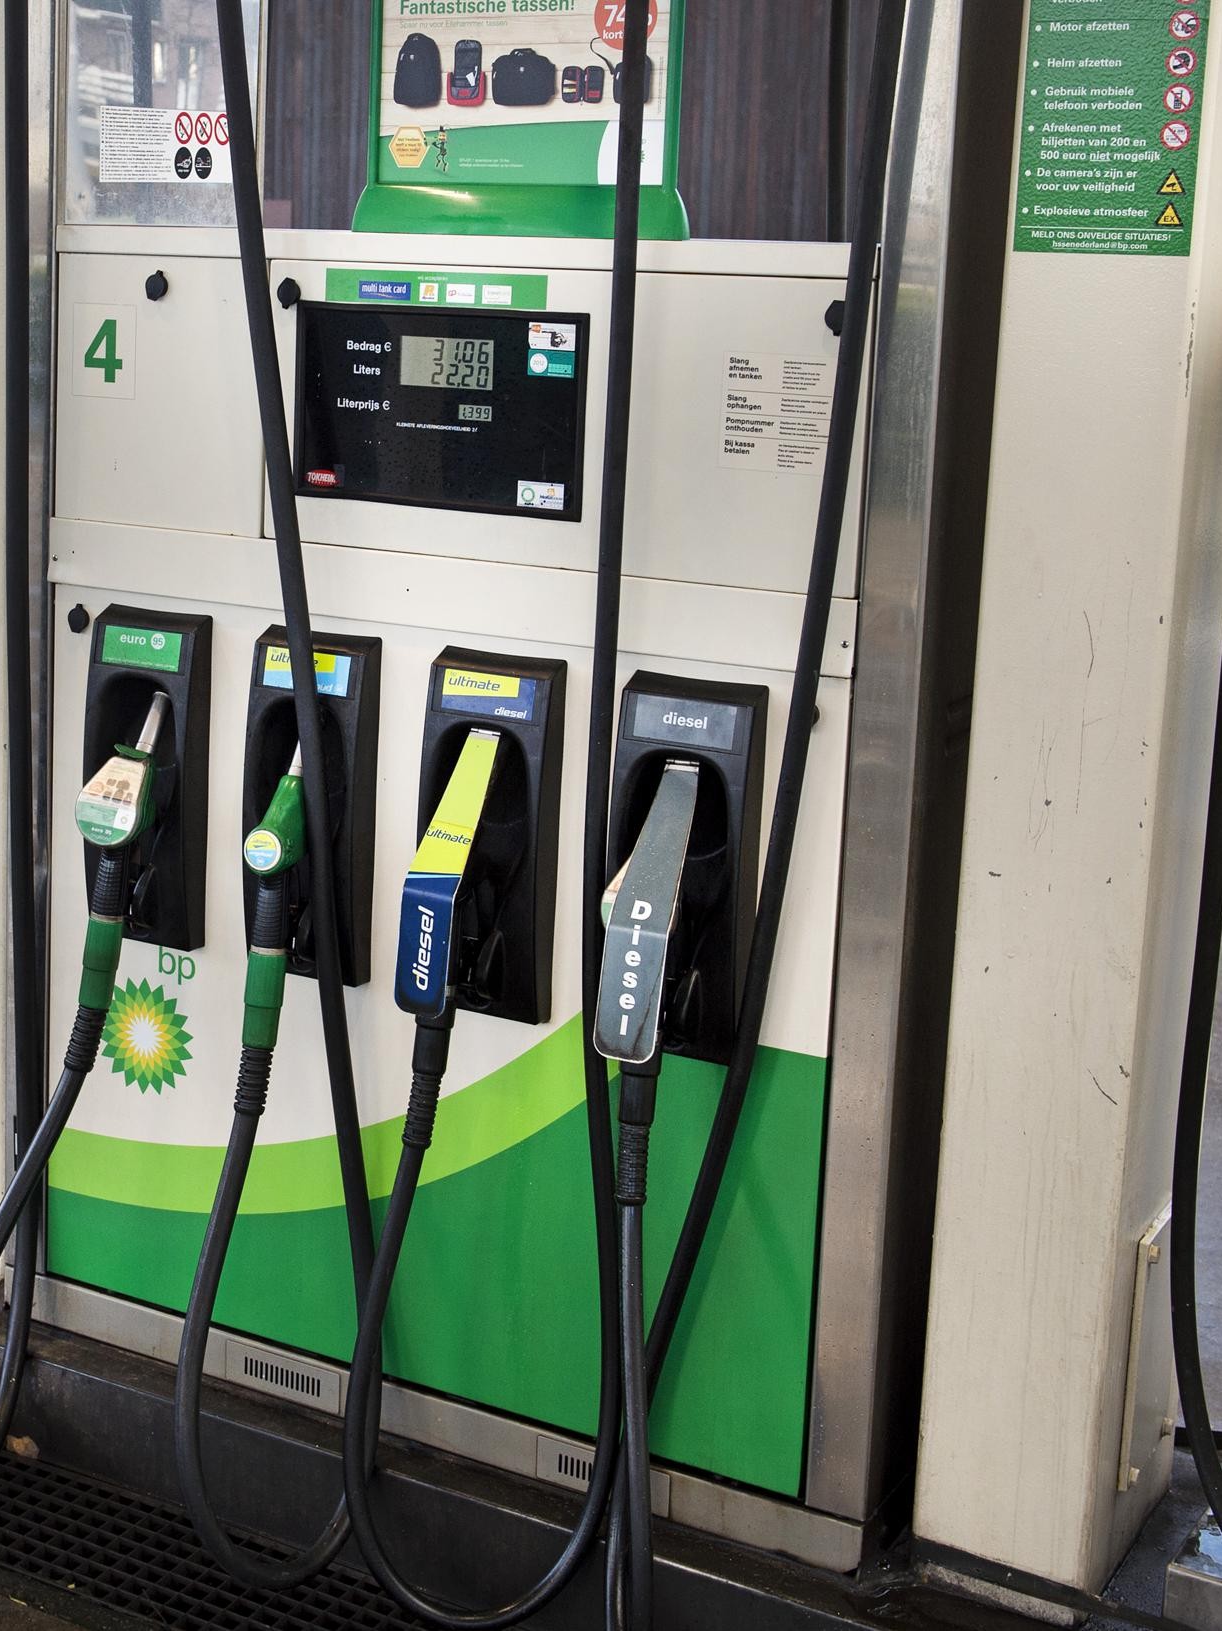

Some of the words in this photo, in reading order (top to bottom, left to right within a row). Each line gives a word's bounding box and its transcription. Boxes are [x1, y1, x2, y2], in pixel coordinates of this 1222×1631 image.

[400, 0, 506, 15] Fantastische
[512, 0, 575, 12] tassen!
[1049, 22, 1082, 32] Motor
[1085, 22, 1130, 32] afzetten
[1047, 58, 1075, 68] Helm
[1078, 58, 1122, 68] afzetten
[1045, 87, 1088, 97] Gebruik
[1090, 87, 1134, 97] mobiele
[1044, 101, 1089, 110] telefoon
[1091, 101, 1142, 111] verboden
[1042, 123, 1096, 133] Afrekenen
[1100, 124, 1122, 133] met
[1041, 137, 1085, 147] biljetten
[1087, 139, 1107, 147] van
[1110, 138, 1130, 147] 200
[1133, 139, 1146, 147] en
[1040, 151, 1060, 160] 500
[1062, 152, 1086, 161] euro
[1089, 151, 1110, 161] niet
[1113, 152, 1161, 163] mogelijk
[1037, 168, 1051, 178] De
[1054, 168, 1101, 178] camera's
[1104, 168, 1123, 180] zijn
[1126, 170, 1138, 178] er
[1036, 183, 1060, 191] voor
[1062, 183, 1080, 191] uw
[1082, 182, 1135, 193] veiligheid
[1033, 206, 1091, 217] Explosieve
[1093, 207, 1149, 217] atmosfeer
[1031, 231, 1055, 239] MELD
[1057, 231, 1076, 239] ONS
[1077, 231, 1123, 240] ONVEILIGE
[1125, 233, 1171, 242] SITUATIES!
[1052, 240, 1148, 250] hssenederland@bp.com
[361, 283, 377, 294] multi
[378, 283, 392, 295] tank
[393, 284, 407, 294] card
[84, 318, 123, 383] 4
[346, 340, 381, 353] Bedrag
[384, 341, 392, 353] €
[729, 357, 749, 366] Slang
[353, 364, 381, 376] Liters
[729, 365, 759, 373] afnemen
[739, 372, 763, 380] tanken
[337, 397, 380, 411] Literprijs
[382, 400, 390, 411] €
[727, 394, 747, 403] Slang
[726, 402, 762, 411] ophangen
[725, 417, 774, 427] Pompnummer
[725, 425, 763, 433] onthouden
[724, 439, 734, 448] Bij
[734, 440, 755, 448] kassa
[724, 447, 750, 455] betalen
[120, 634, 146, 645] euro
[152, 637, 164, 646] 95
[448, 675, 500, 691] ultimate
[494, 707, 528, 719] diesel
[662, 711, 708, 730] diesel
[427, 829, 472, 845] ultimate
[412, 904, 435, 991] diesel
[158, 944, 196, 985] bp
[618, 900, 653, 1036] Diesel
